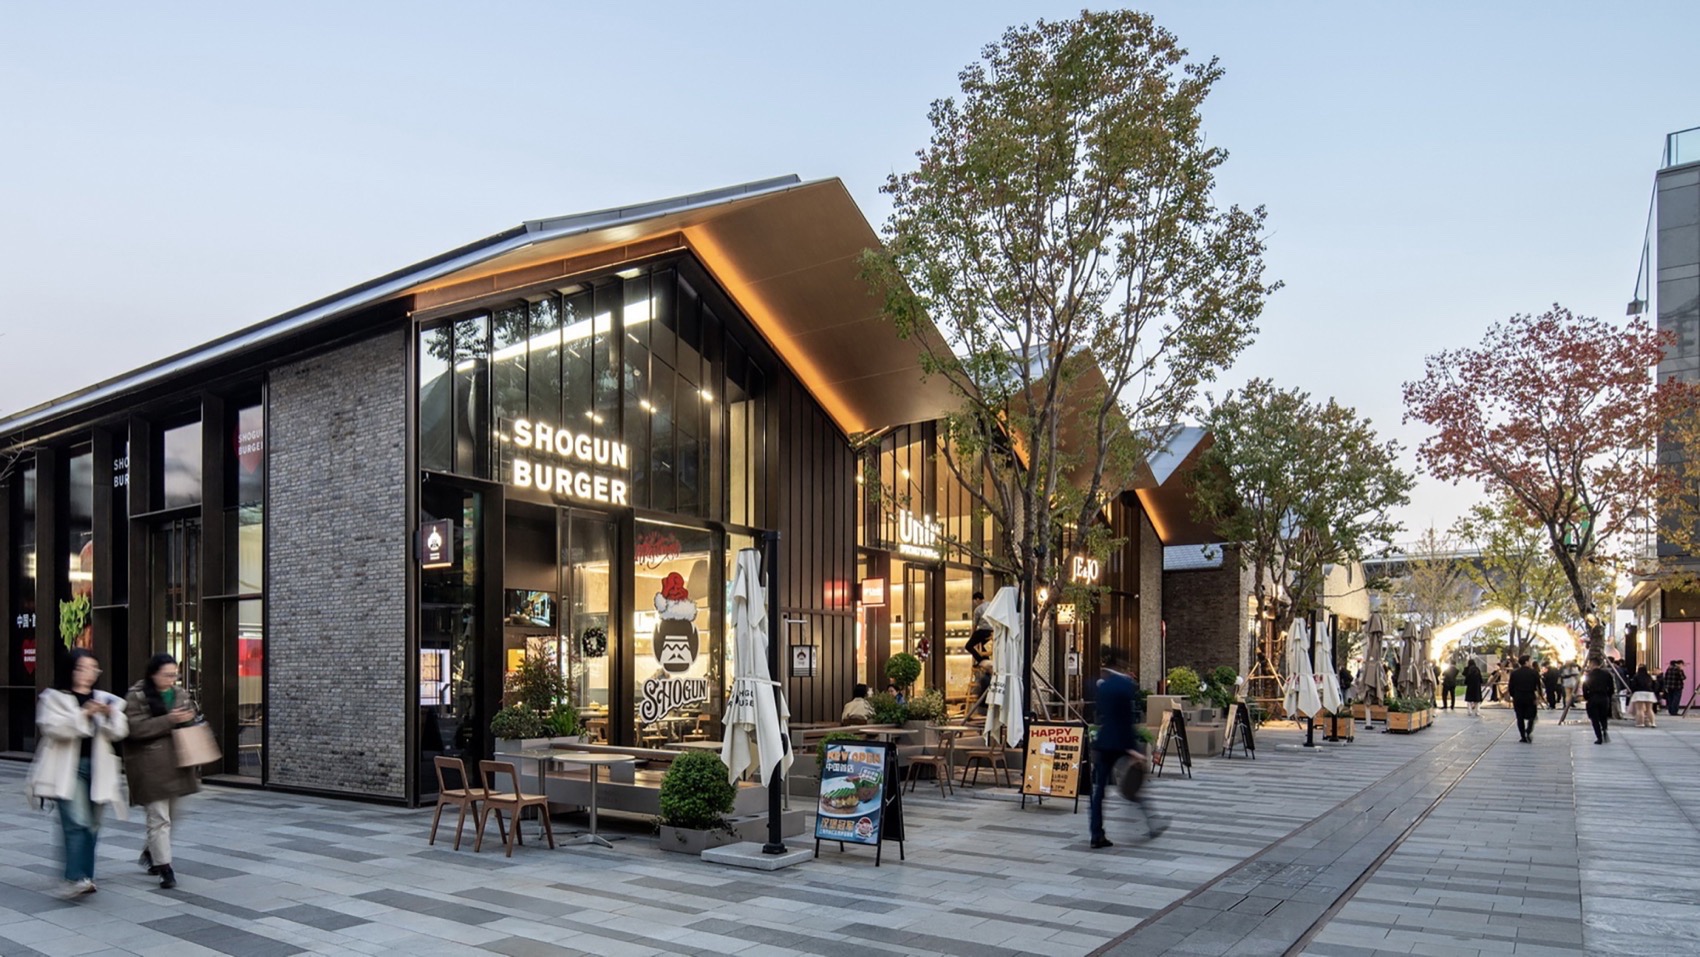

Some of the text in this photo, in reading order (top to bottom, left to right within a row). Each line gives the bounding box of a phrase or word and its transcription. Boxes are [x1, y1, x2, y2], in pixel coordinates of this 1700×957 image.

[514, 419, 628, 469] SHOGUN
[514, 459, 628, 506] BURGER
[641, 678, 708, 722] SHOGUN
[1031, 728, 1072, 737] HAPPY
